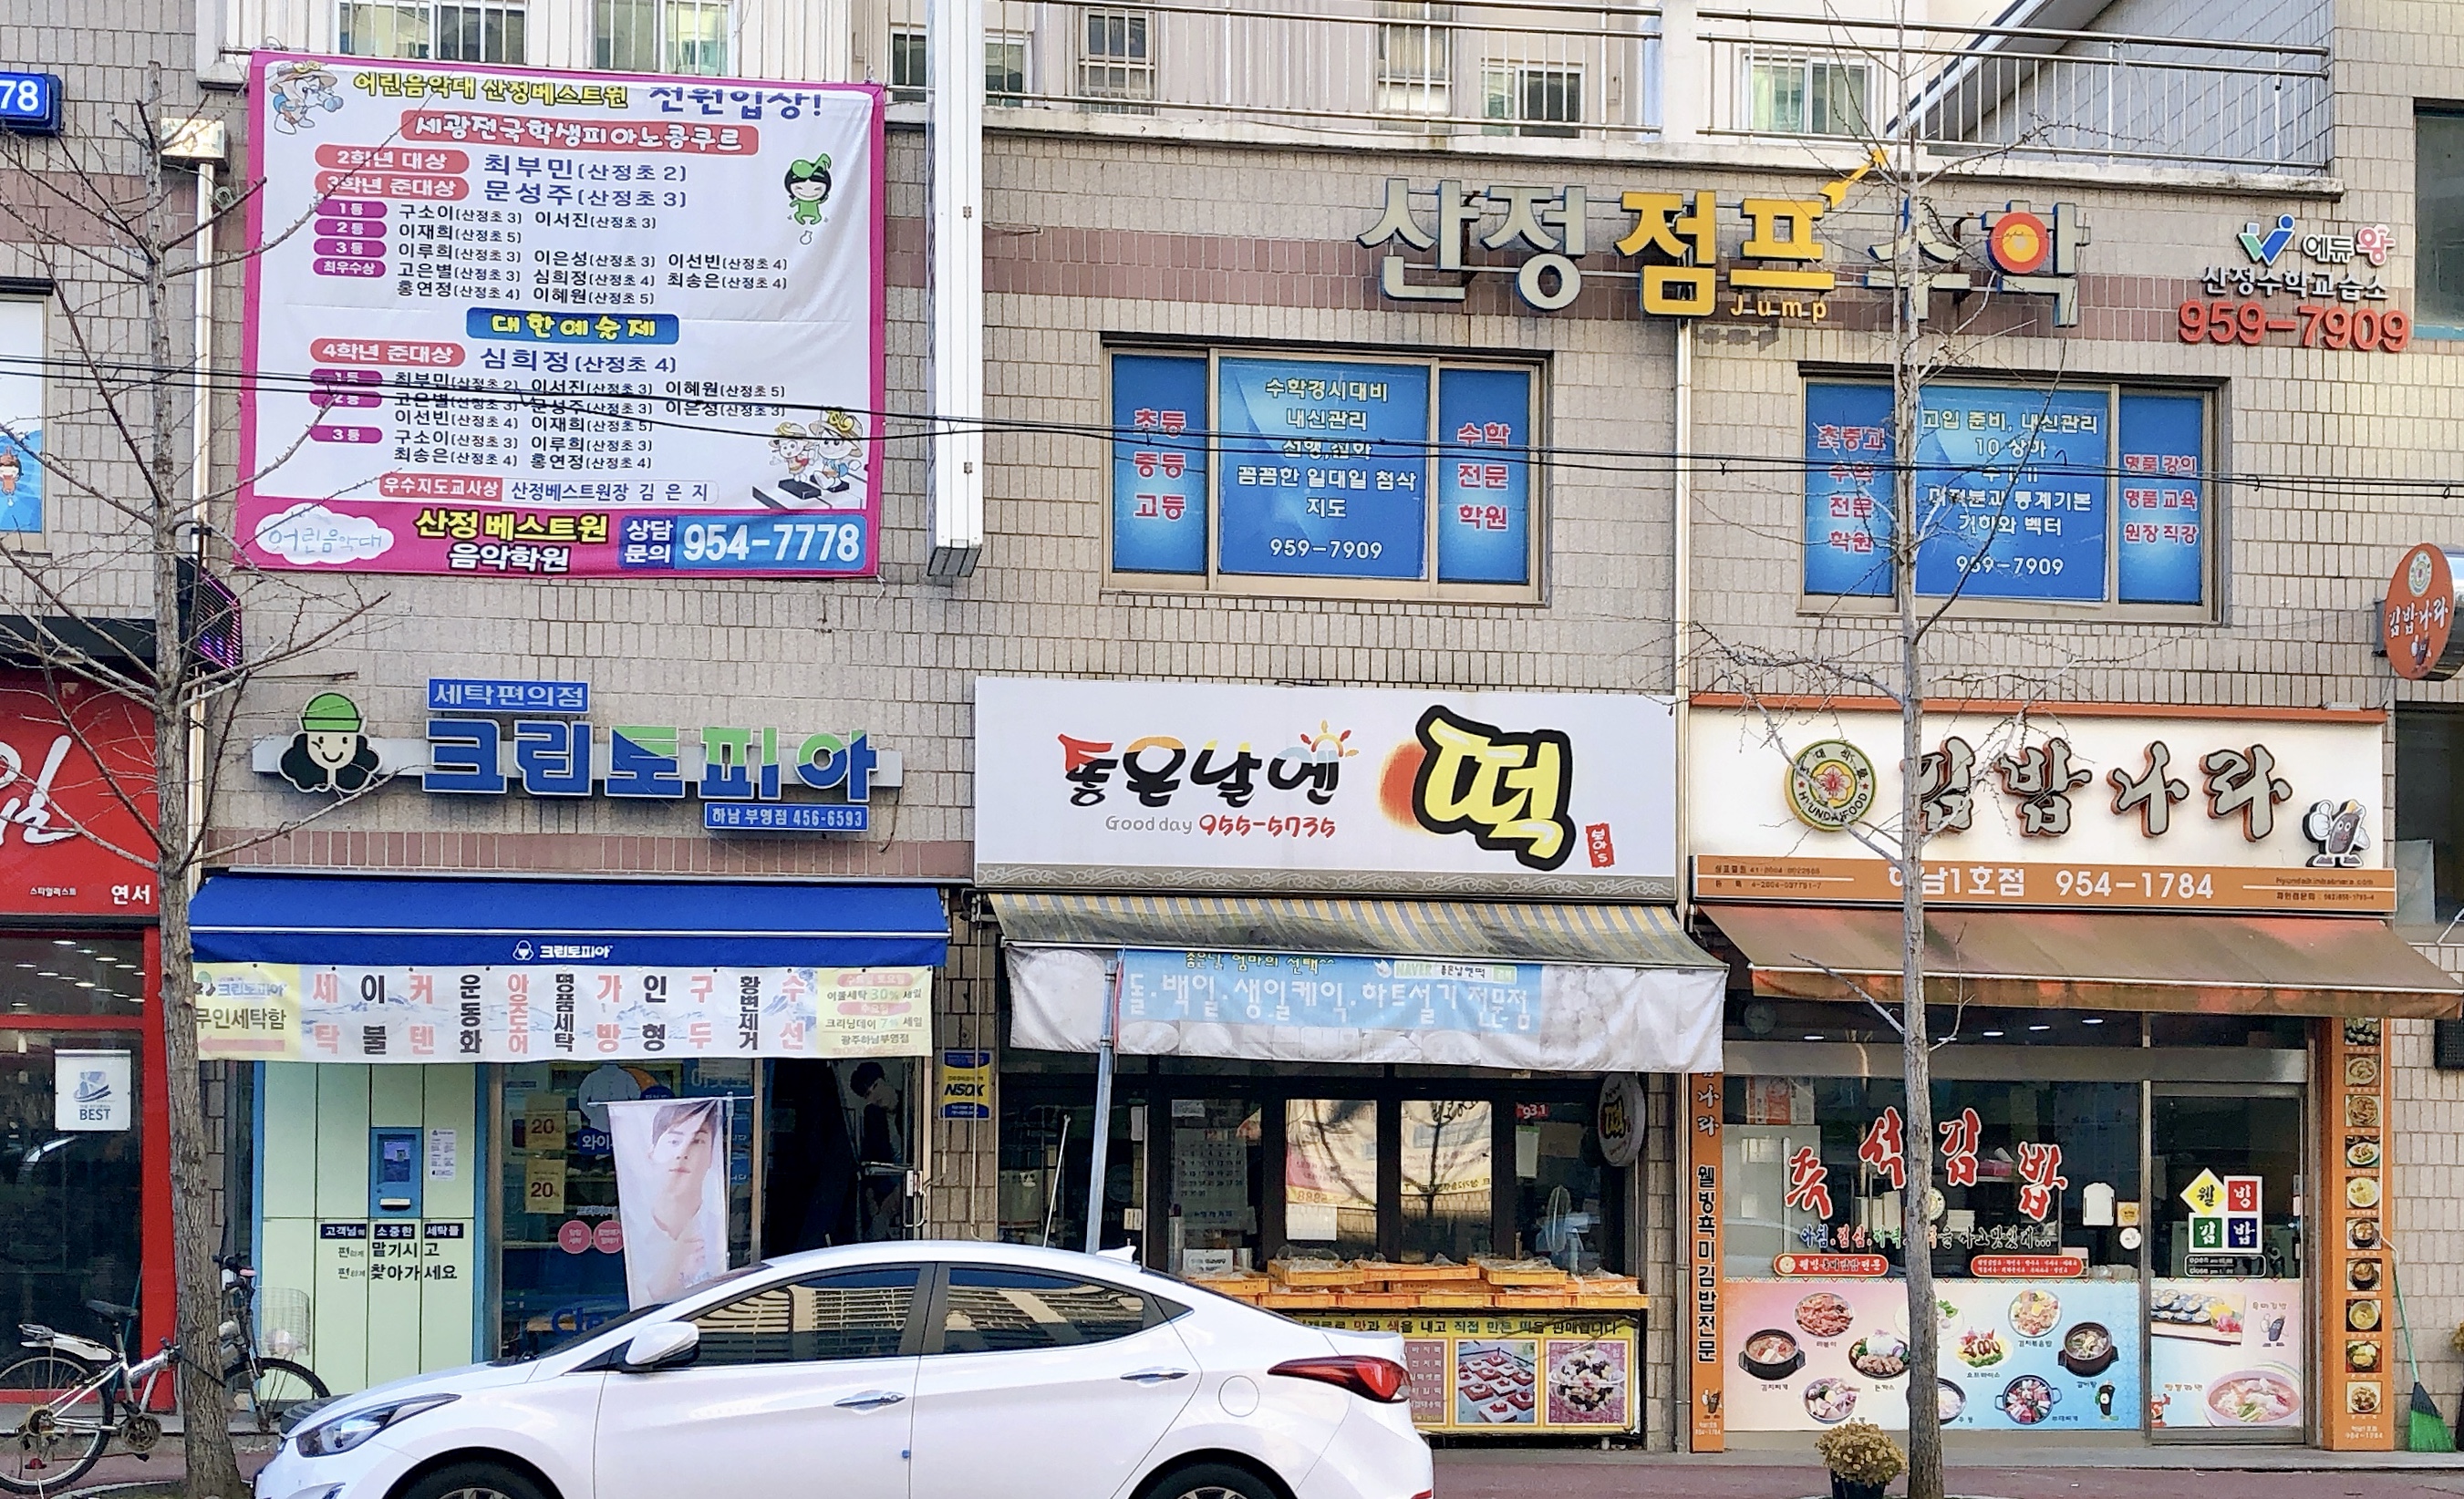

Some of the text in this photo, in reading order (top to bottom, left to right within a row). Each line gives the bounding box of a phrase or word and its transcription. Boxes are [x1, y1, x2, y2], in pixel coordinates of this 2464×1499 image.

[353, 72, 822, 119] 어린음악대 산정베스트원 전원입상!
[415, 114, 742, 151] 세광전국학생피아노콩쿠르
[336, 149, 447, 171] 2학년 대상
[389, 177, 456, 197] 준대상
[339, 202, 364, 216] 1등
[336, 222, 364, 236] 2등
[336, 242, 363, 255] 3등
[2302, 224, 2396, 266] 에듀왕
[324, 261, 376, 274] 최우수상
[2202, 265, 2389, 301] 산정수학교습소
[1730, 295, 1827, 324] Jump
[2179, 300, 2409, 352] 959-7909
[322, 343, 454, 364] 4학년 준대상
[1266, 378, 1389, 402] 수학경시대비
[1134, 408, 1185, 439] 초등
[1287, 409, 1367, 431] 내신관리
[1923, 409, 2098, 434] 고입 준비, 내신관리
[333, 429, 360, 441] 3등
[1458, 422, 1509, 447] 수학
[1134, 453, 1185, 479] 중등
[2124, 454, 2197, 476] 명품 강의
[384, 476, 629, 501] 우수지도교사상 산정베스트원장
[1238, 466, 1416, 492] 꼼꼼한 일대일 첨삭
[1458, 465, 1509, 490] 전문
[1134, 495, 1185, 521] 고등
[1307, 498, 1347, 519] 지도
[1829, 496, 1873, 518] 전문
[2014, 491, 2092, 512] 통계기본
[2124, 489, 2198, 512] 명품 교육
[416, 510, 608, 543] 산정 베스트원
[1458, 506, 1508, 530] 학원
[2024, 516, 2062, 536] 벡터
[268, 527, 382, 554] 어린음악대
[626, 521, 673, 540] 상담
[683, 523, 860, 562] 954-7778
[1829, 530, 1873, 553] 학원
[2125, 522, 2197, 544] 원장 직강
[449, 543, 569, 573] 음악학원
[624, 545, 671, 564] 문의
[1270, 539, 1382, 560] 959-7909
[2388, 595, 2449, 638] 김밥나라
[433, 684, 585, 708] 세탁편의점
[421, 718, 879, 803] 크린토피아
[1057, 705, 1571, 869] 좋은날엔 떡
[1900, 735, 2293, 843] 김밥나라
[712, 808, 864, 828] 하남 부영점 456-6593
[1199, 814, 1336, 838] 955-5735
[29, 884, 150, 905] 스타일리스트 연서
[2055, 869, 2214, 900] 954-1784
[539, 945, 611, 959] 크린토피아
[1232, 954, 1279, 972] 엄마의
[1396, 961, 1432, 977] NAVER
[827, 988, 921, 1001] 이불세탁 30% 세일
[196, 1008, 286, 1029] 무인세탁함
[313, 973, 339, 1054] 세탁
[361, 974, 387, 1055] 이불
[409, 974, 434, 1056] 커텐
[460, 974, 482, 1054] 운동화
[507, 973, 531, 1053] 아웃도어
[554, 972, 575, 1052] 명품세탁
[596, 974, 623, 1053] 가방
[642, 974, 668, 1051] 인형
[688, 975, 712, 1049] 구두
[739, 976, 761, 1050] 황변제거
[780, 975, 805, 1050] 수선
[1468, 987, 1530, 1030] 전문점
[825, 1019, 876, 1029] 크리닝데이
[903, 1017, 922, 1027] 세일
[945, 1084, 985, 1096] NSOK
[79, 1110, 110, 1121] BEST
[377, 1226, 412, 1237] 소중한
[426, 1225, 460, 1236] 세탁물
[371, 1242, 440, 1258] 맡기시고
[370, 1264, 458, 1281] 찾아가세요
[1354, 1320, 1380, 1331] 맛과
[1387, 1320, 1413, 1333] 색을
[1421, 1321, 1446, 1332] 내고
[1455, 1321, 1478, 1333] 직접
[1487, 1321, 1512, 1333] 만든
